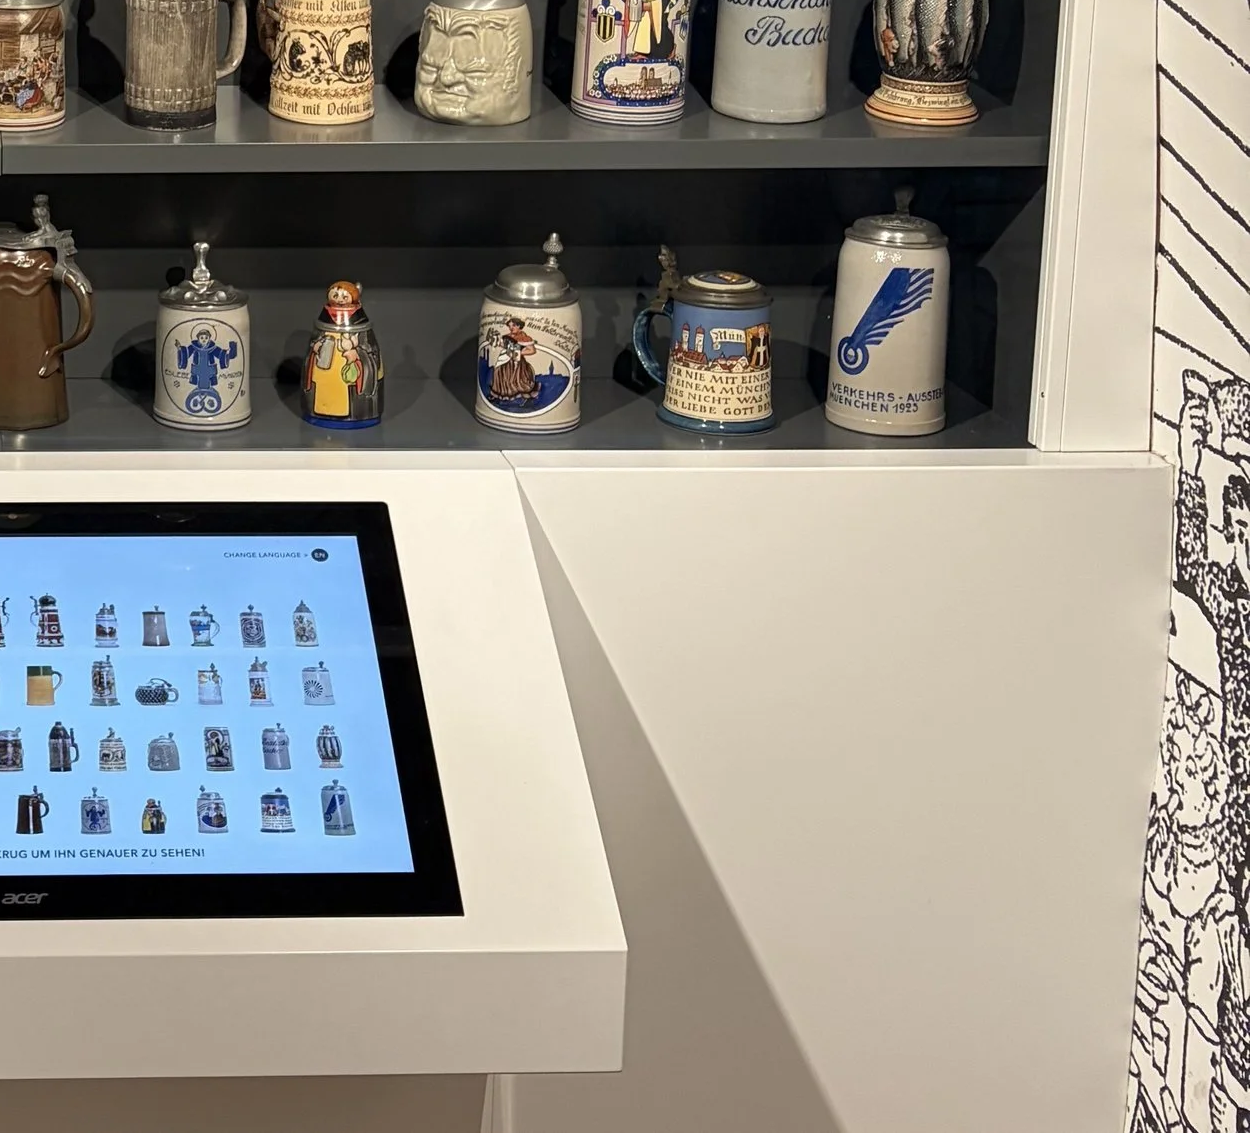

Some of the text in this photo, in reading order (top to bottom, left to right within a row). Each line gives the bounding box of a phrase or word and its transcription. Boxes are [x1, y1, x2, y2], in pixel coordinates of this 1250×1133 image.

[685, 370, 706, 383] NIE
[709, 374, 738, 385] MIT
[675, 378, 716, 394] EINEM
[832, 381, 896, 403] VERKEHRS
[687, 391, 732, 405] NICHT
[735, 395, 763, 405] WAS
[681, 401, 718, 415] LIEBE
[723, 406, 756, 416] GOTT
[31, 849, 50, 859] UM
[54, 849, 76, 858] IHN
[79, 848, 138, 858] GENAUER
[141, 848, 157, 857] ZU
[160, 848, 205, 857] SEHEN!
[1, 892, 49, 905] acer
